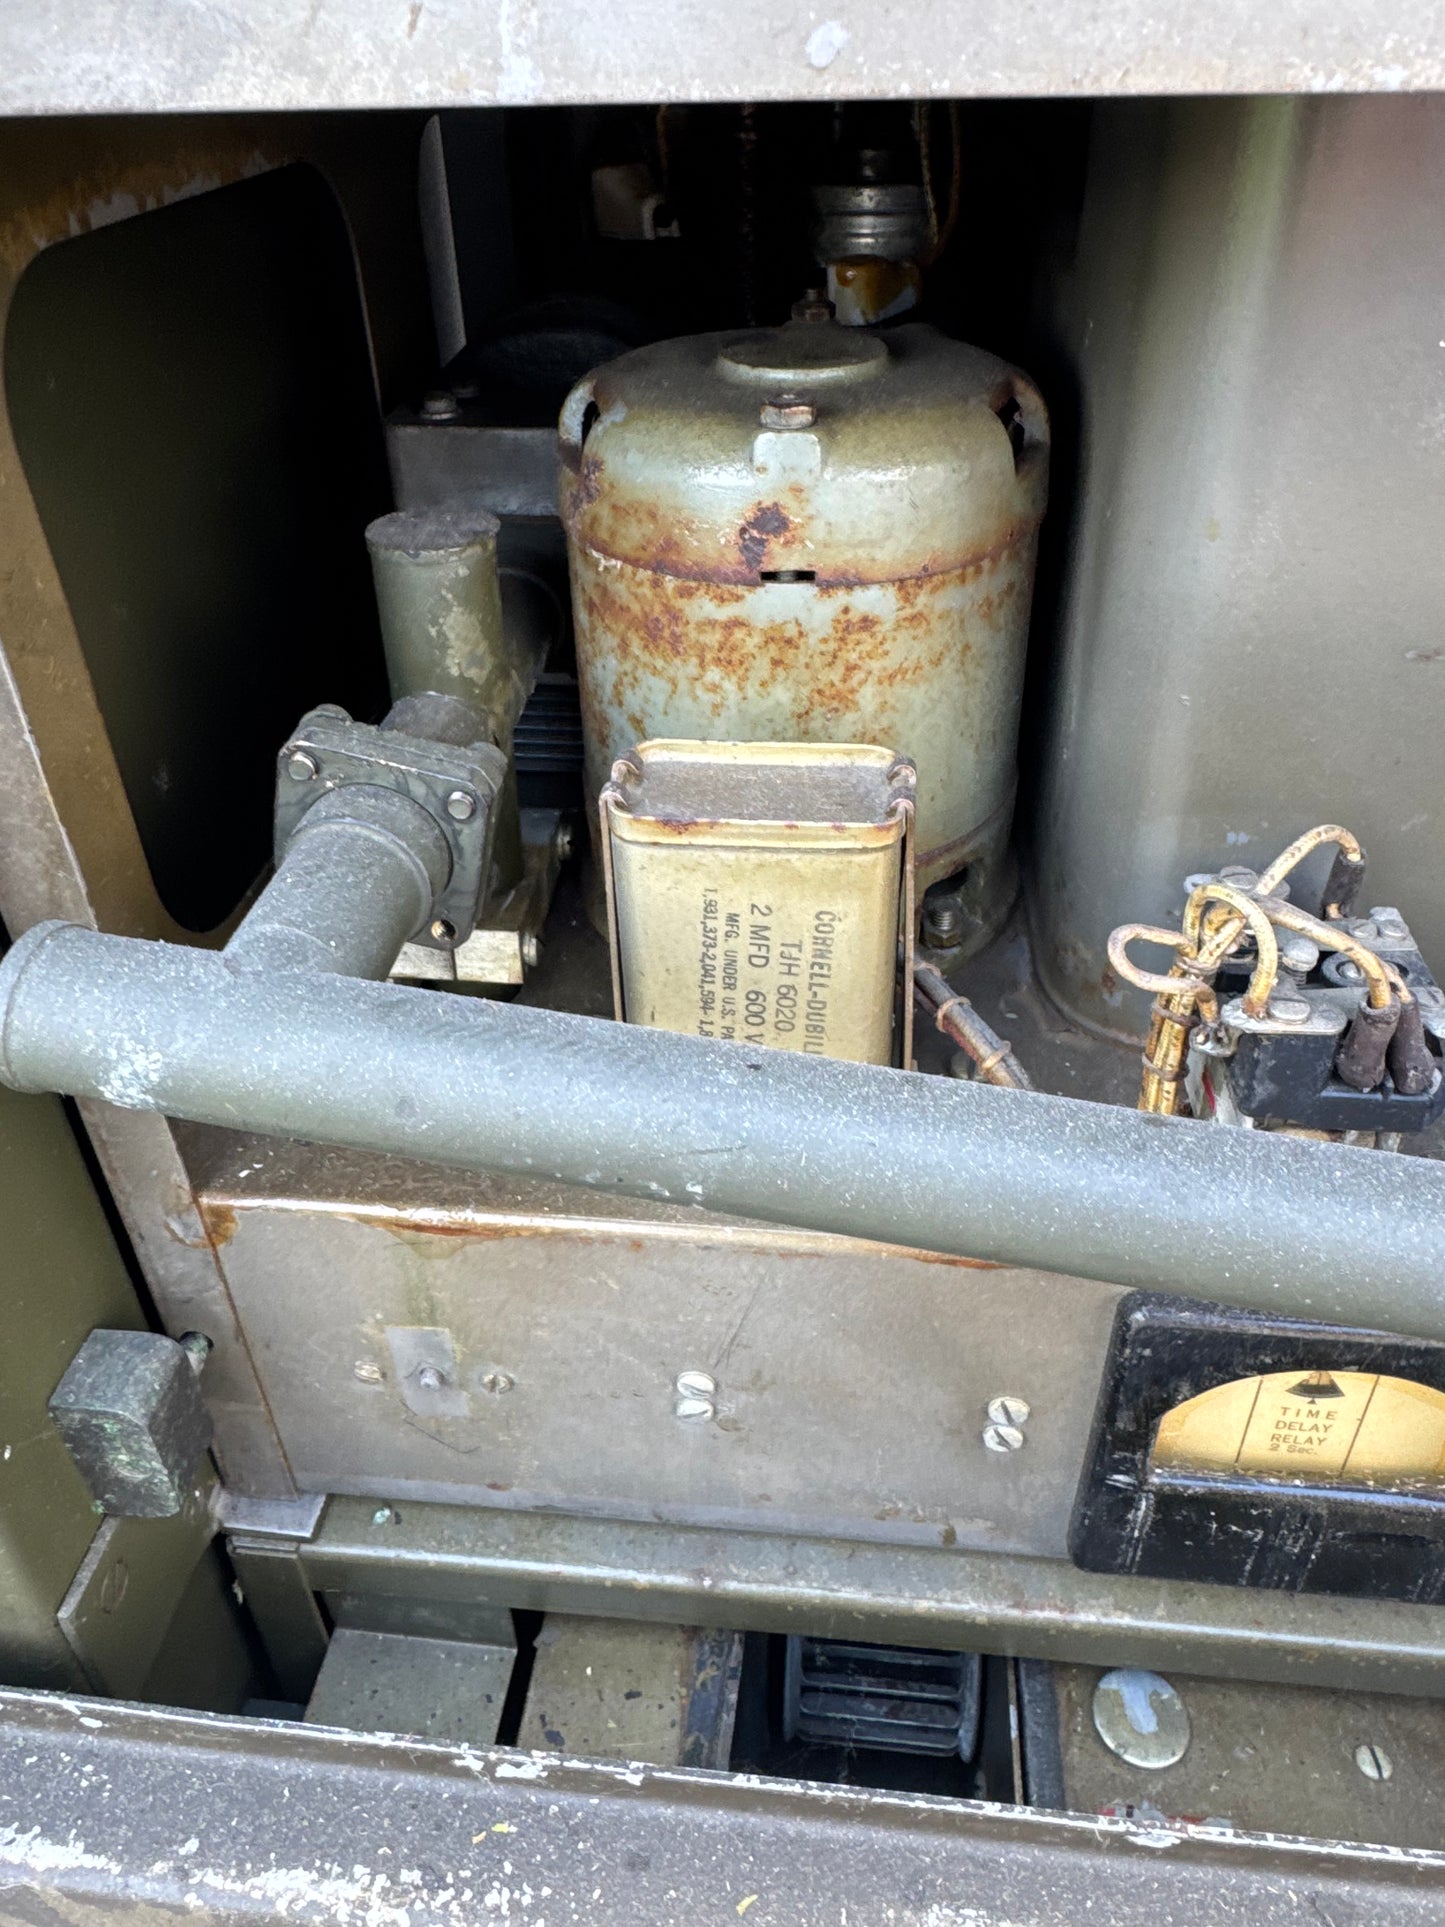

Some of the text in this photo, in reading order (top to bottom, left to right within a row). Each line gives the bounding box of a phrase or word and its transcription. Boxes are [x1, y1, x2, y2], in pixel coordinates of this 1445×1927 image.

[750, 903, 773, 917] 2
[724, 912, 740, 942] MFG.
[748, 924, 771, 969] MFD
[722, 950, 738, 991] UNDER
[774, 940, 803, 1033] TJH 6020
[721, 997, 736, 1020] U.S.
[744, 990, 767, 1027] 600
[1281, 1406, 1338, 1420] TIME
[1275, 1420, 1333, 1433] DELAY
[1269, 1443, 1318, 1455] 2 Sec.
[1270, 1433, 1328, 1446] RELAY
